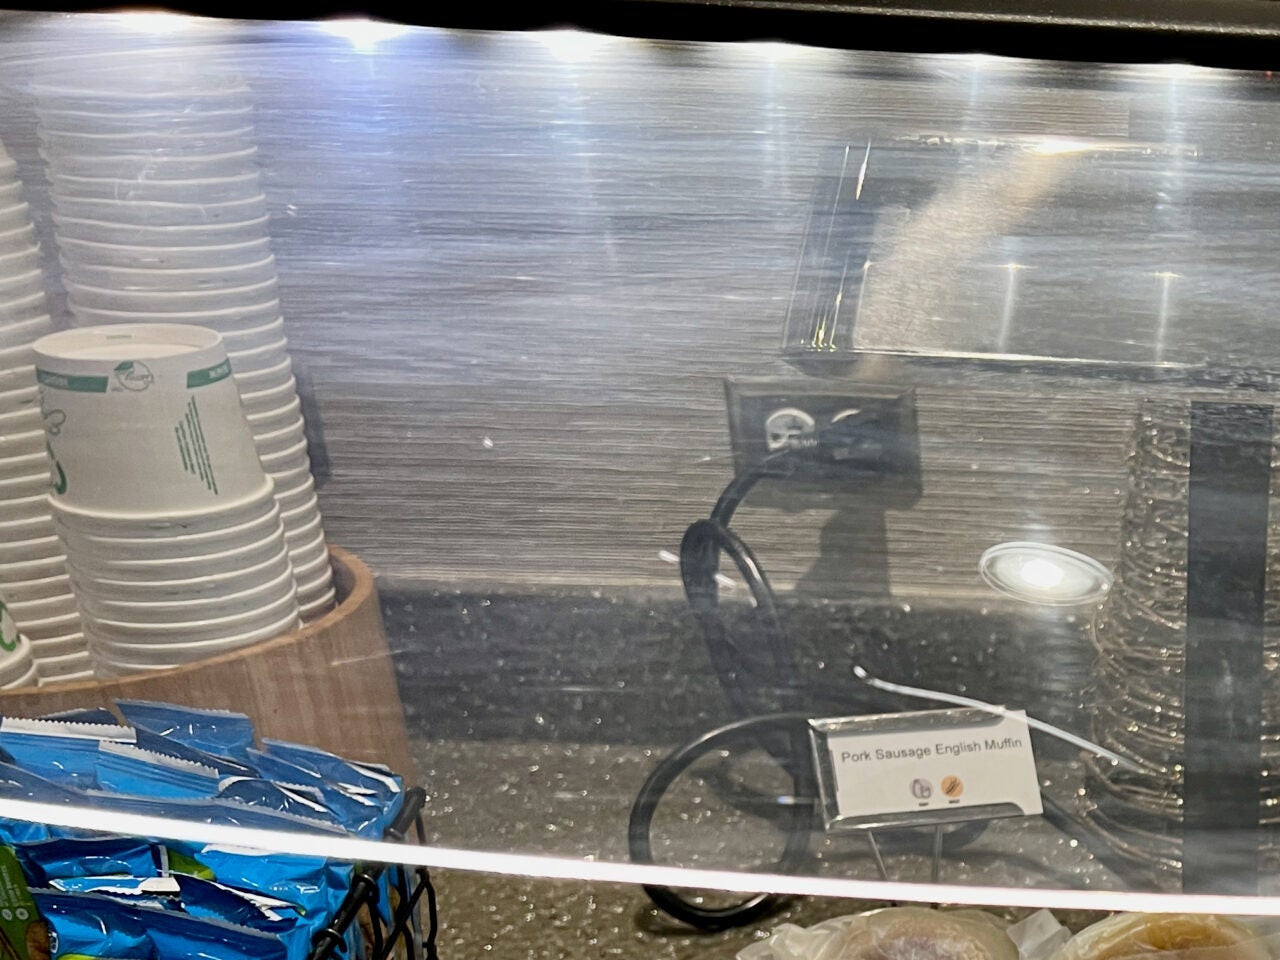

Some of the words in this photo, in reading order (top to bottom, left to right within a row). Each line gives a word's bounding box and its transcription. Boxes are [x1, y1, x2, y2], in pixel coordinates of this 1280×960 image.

[841, 751, 872, 763] Pork
[875, 748, 932, 760] Sausage
[935, 740, 982, 756] English
[984, 738, 1023, 751] Muffin
